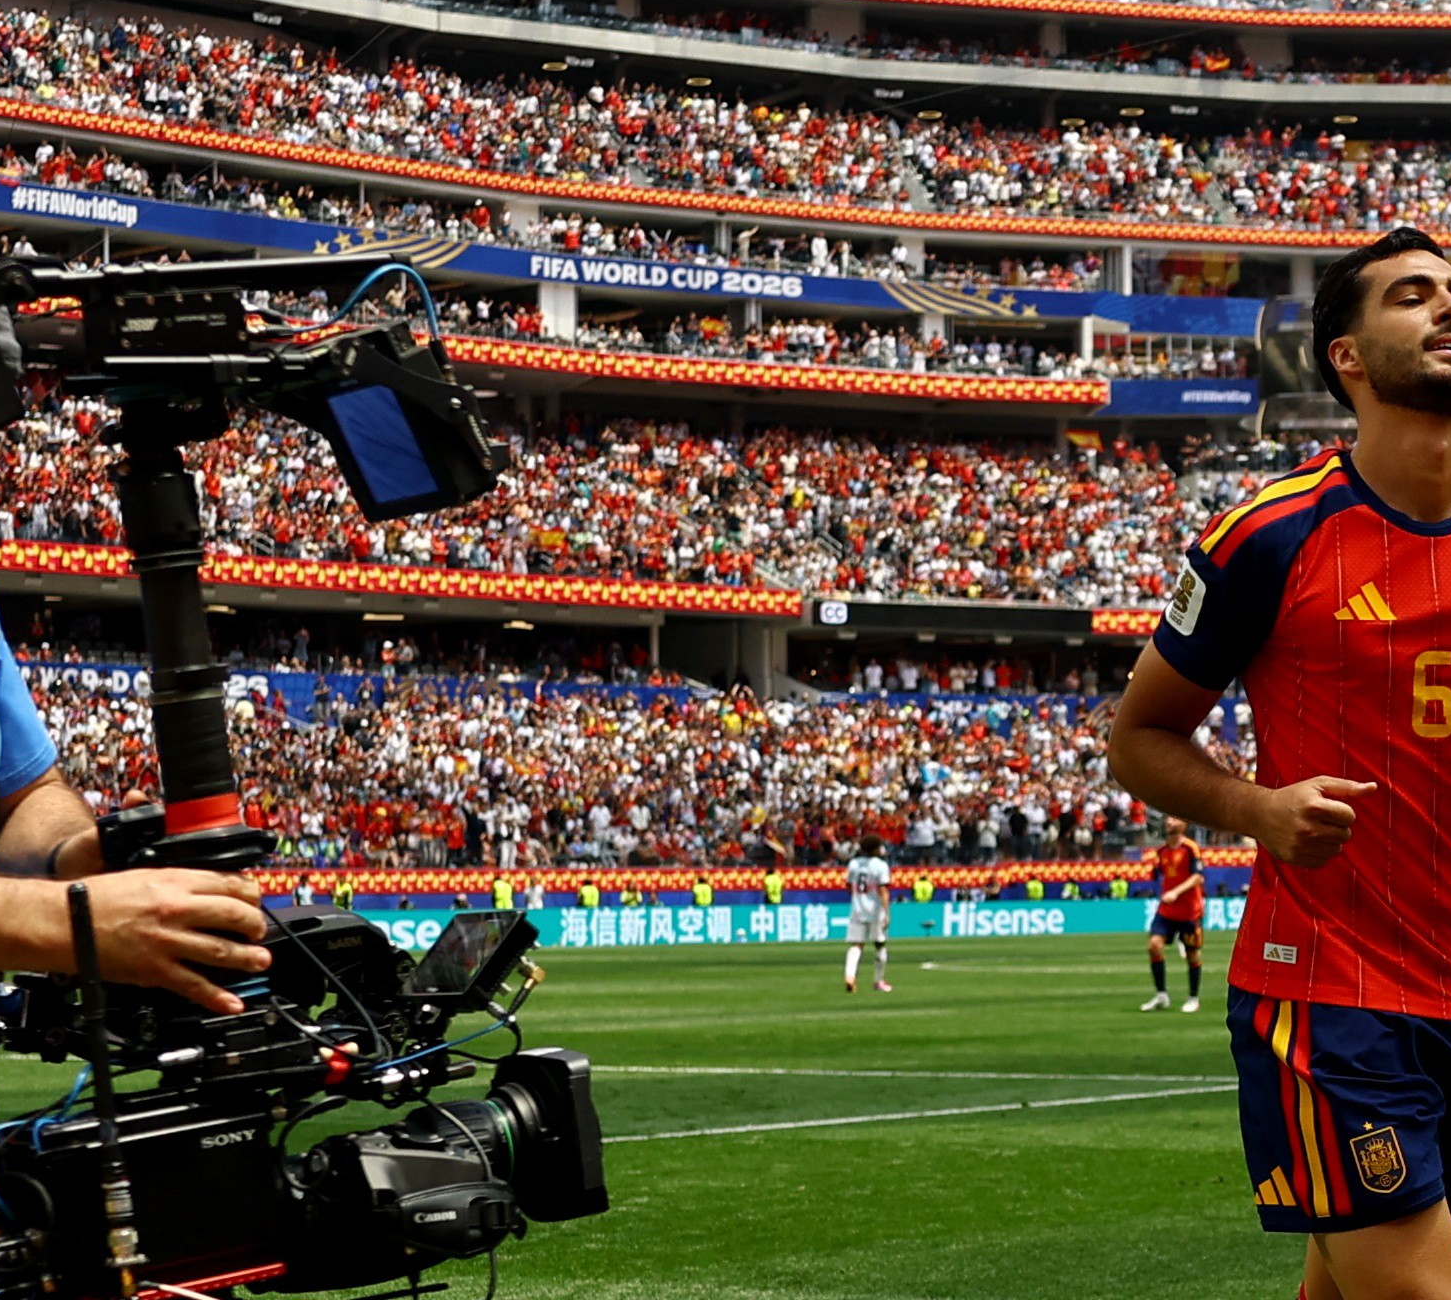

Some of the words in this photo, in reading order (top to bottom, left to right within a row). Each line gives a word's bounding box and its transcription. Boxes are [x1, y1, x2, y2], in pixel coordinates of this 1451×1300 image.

[12, 186, 138, 228] #FIFAWorldCup
[530, 255, 579, 281] FIFA
[580, 259, 668, 287] WORLD
[671, 265, 719, 290] CUP
[722, 272, 804, 298] 2026
[560, 905, 733, 947] 海信新风空调
[750, 903, 849, 943] 中国第一
[942, 902, 1065, 936] Hisense
[200, 1128, 256, 1149] SONY
[413, 1210, 457, 1224] Canon
